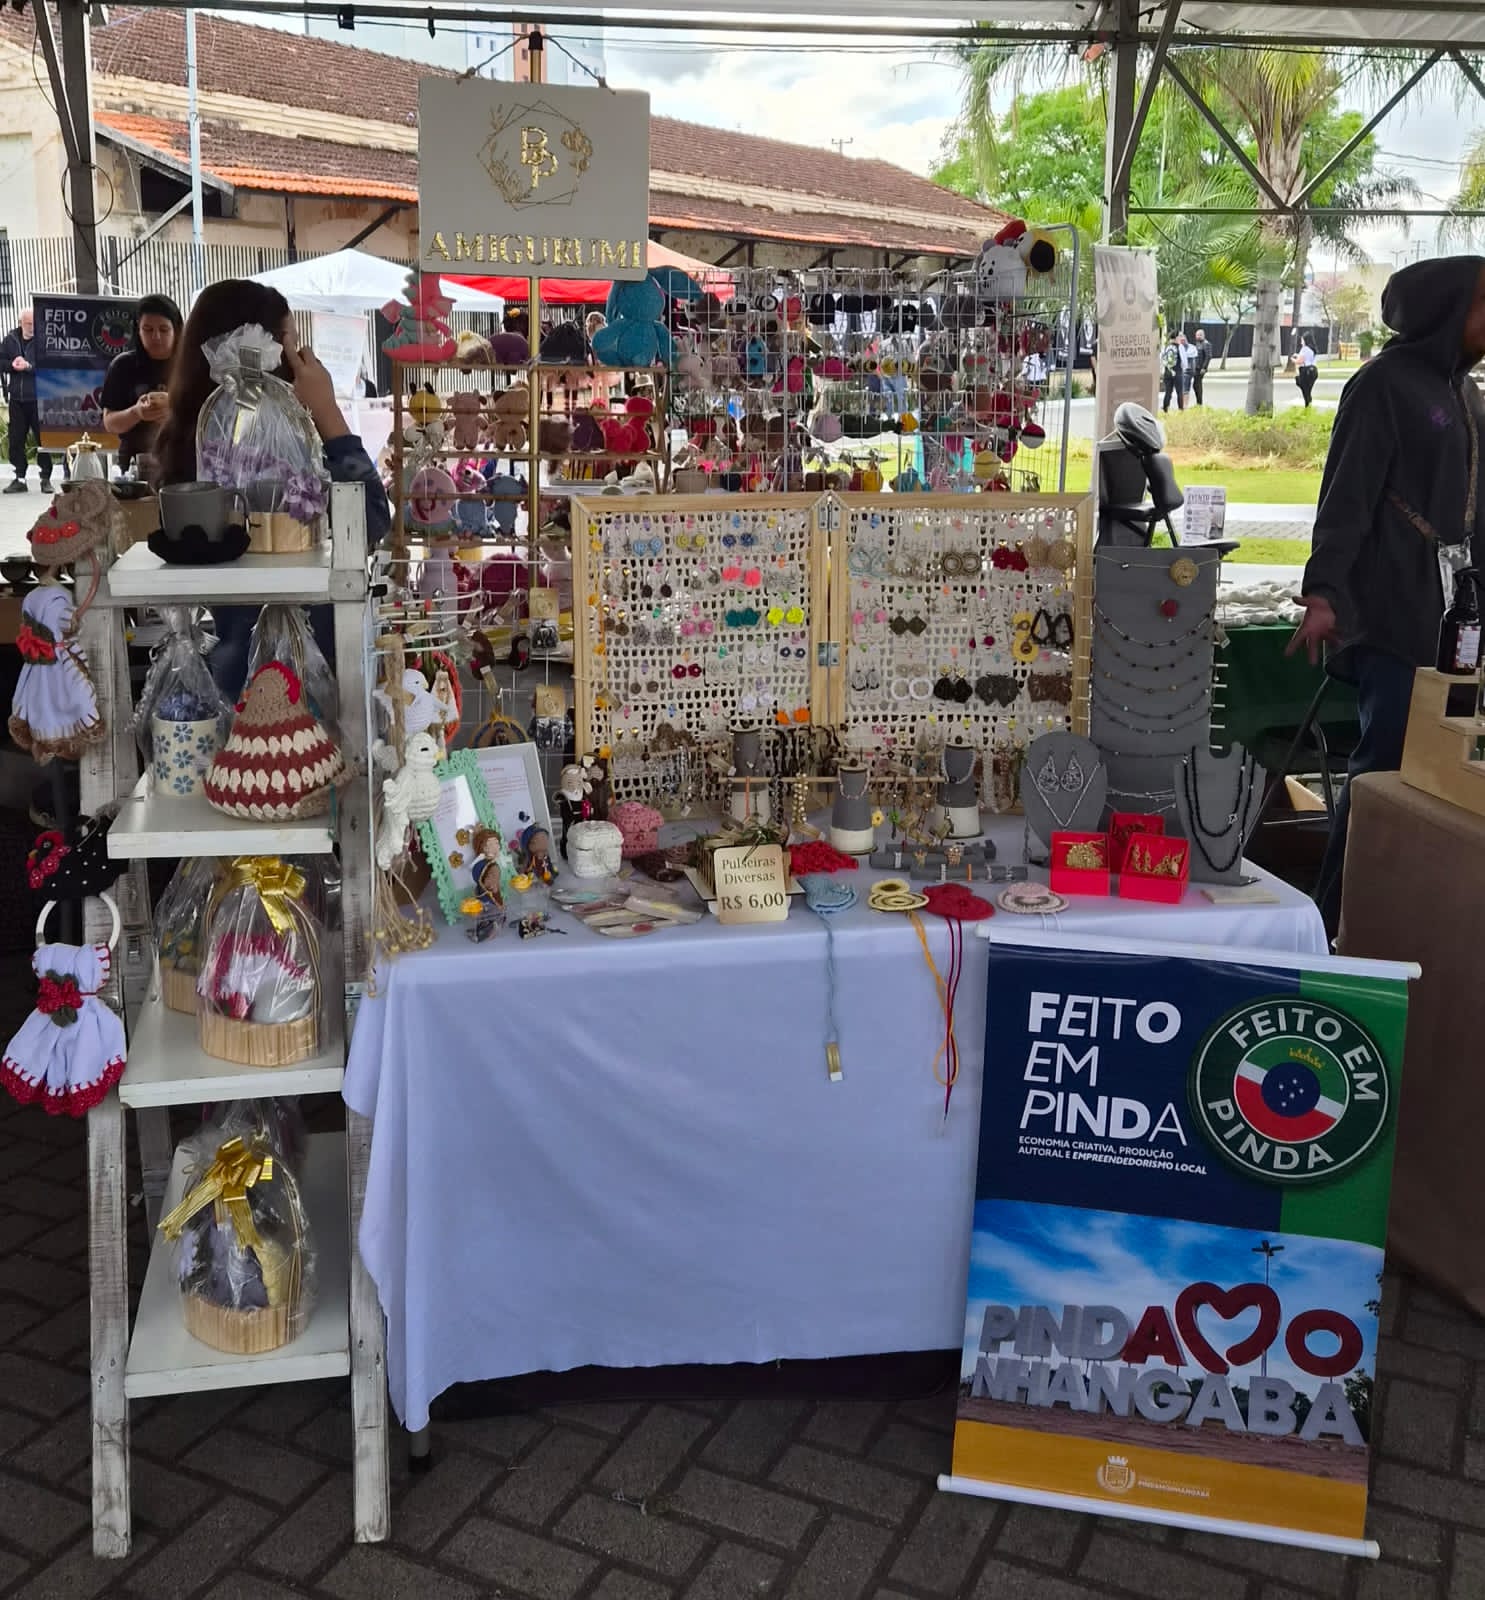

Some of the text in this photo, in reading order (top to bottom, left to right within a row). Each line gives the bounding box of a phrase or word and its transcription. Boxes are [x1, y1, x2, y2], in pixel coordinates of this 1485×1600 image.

[424, 230, 641, 269] AMIGURUMI
[45, 309, 87, 322] FEITO
[46, 322, 66, 336] EM
[46, 337, 91, 350] PINDA
[1110, 346, 1152, 360] INTEGRATIVA
[722, 857, 776, 870] Pulseiras
[724, 872, 776, 885] Diversas
[748, 892, 784, 910] 6,00
[1027, 991, 1182, 1044] FEITO
[1023, 1040, 1100, 1087] EM
[1228, 1007, 1380, 1100] FEITO EM
[1019, 1089, 1188, 1146] PINDA
[1207, 1097, 1335, 1170] PINDA
[1018, 1136, 1070, 1149] ECONOMIA
[1119, 1146, 1174, 1160] PRODUÇÃO
[1018, 1146, 1207, 1175] AUTORAL E EMPREENDEDORISMO LOCAL
[971, 1356, 1367, 1447] NHANGABA
